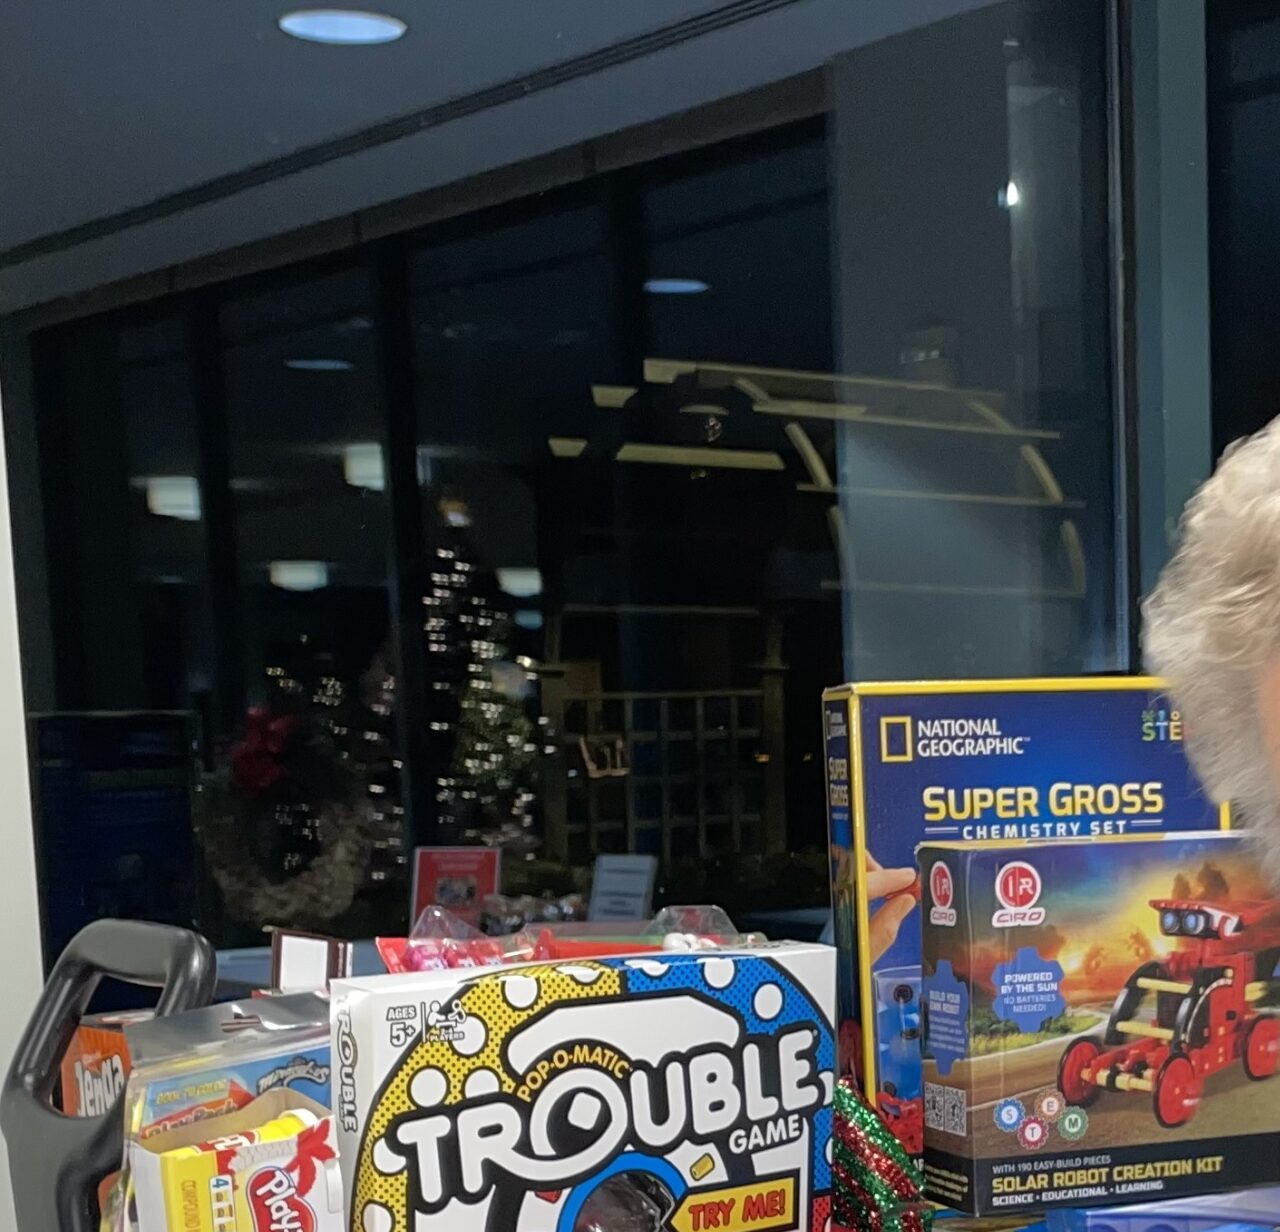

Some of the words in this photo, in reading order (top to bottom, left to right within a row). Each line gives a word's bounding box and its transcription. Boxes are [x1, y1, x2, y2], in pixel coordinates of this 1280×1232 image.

[917, 718, 1001, 737] NATIONAL
[1141, 721, 1184, 742] STE
[917, 737, 1024, 757] GEOGRAPHIC
[922, 786, 1039, 821] SUPER
[1049, 782, 1164, 817] GROSS
[962, 822, 1081, 840] CHEMISTRY
[1090, 819, 1127, 835] SET
[996, 911, 1042, 924] CIRO
[1004, 972, 1053, 984] POWERED
[1001, 985, 1014, 995] BY
[1016, 983, 1035, 993] THE
[1037, 982, 1058, 992] SUN
[1013, 1003, 1046, 1013] NEEDED!
[1016, 994, 1056, 1004] BATTERIES
[386, 1005, 417, 1021] AGES
[390, 1022, 416, 1047] 5+
[517, 1044, 633, 1102] POP-O-MATIC
[74, 1053, 126, 1117] Jenga
[1005, 1109, 1014, 1121] S
[1046, 1100, 1055, 1113] E
[397, 1029, 820, 1204] TROUBLE
[1068, 1117, 1080, 1129] M
[729, 1114, 801, 1155] GAME
[1029, 1127, 1037, 1138] T
[993, 1162, 1014, 1174] WITH
[1017, 1161, 1032, 1172] 190
[1033, 1158, 1081, 1170] EASY-BUILD
[1084, 1155, 1112, 1166] PIECES
[212, 1178, 229, 1189] 4
[992, 1175, 1049, 1193] SOLAR
[1053, 1168, 1109, 1188] ROBOT
[1113, 1160, 1193, 1182] CREATION
[1196, 1156, 1224, 1174] KIT
[992, 1193, 1034, 1206] SCIENCE
[1042, 1186, 1108, 1201] EDUCATIONAL
[1115, 1180, 1164, 1194] LEARNING
[688, 1198, 736, 1232] TRY
[742, 1188, 786, 1223] ME!
